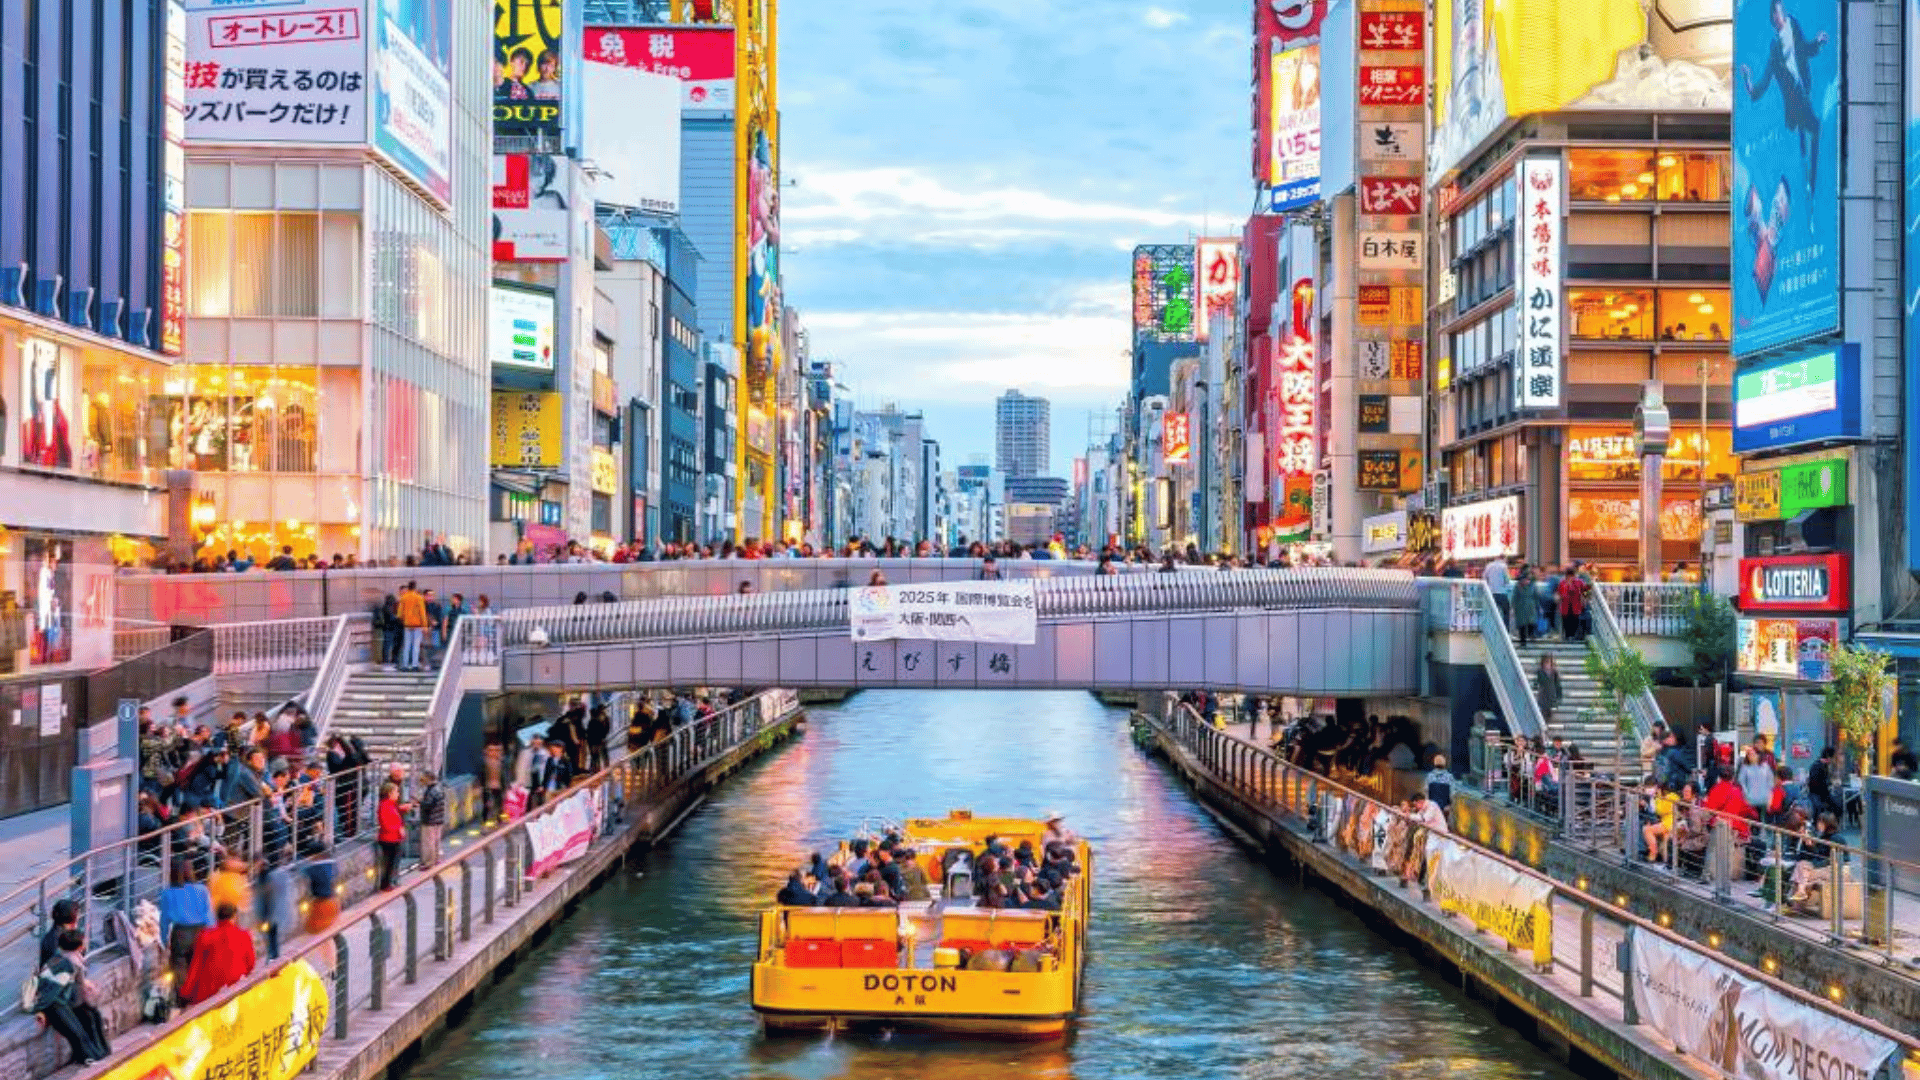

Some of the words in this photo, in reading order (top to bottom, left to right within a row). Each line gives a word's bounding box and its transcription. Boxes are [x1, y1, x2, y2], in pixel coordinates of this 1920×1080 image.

[1363, 236, 1417, 258] 白木屋
[1765, 568, 1822, 596] LOTTERIA
[899, 590, 950, 604] 2025年
[955, 592, 1034, 609] 国際博覧会を
[862, 651, 1011, 674] えびす橋
[864, 974, 957, 993] DOTON
[1737, 1010, 1786, 1071] MGM
